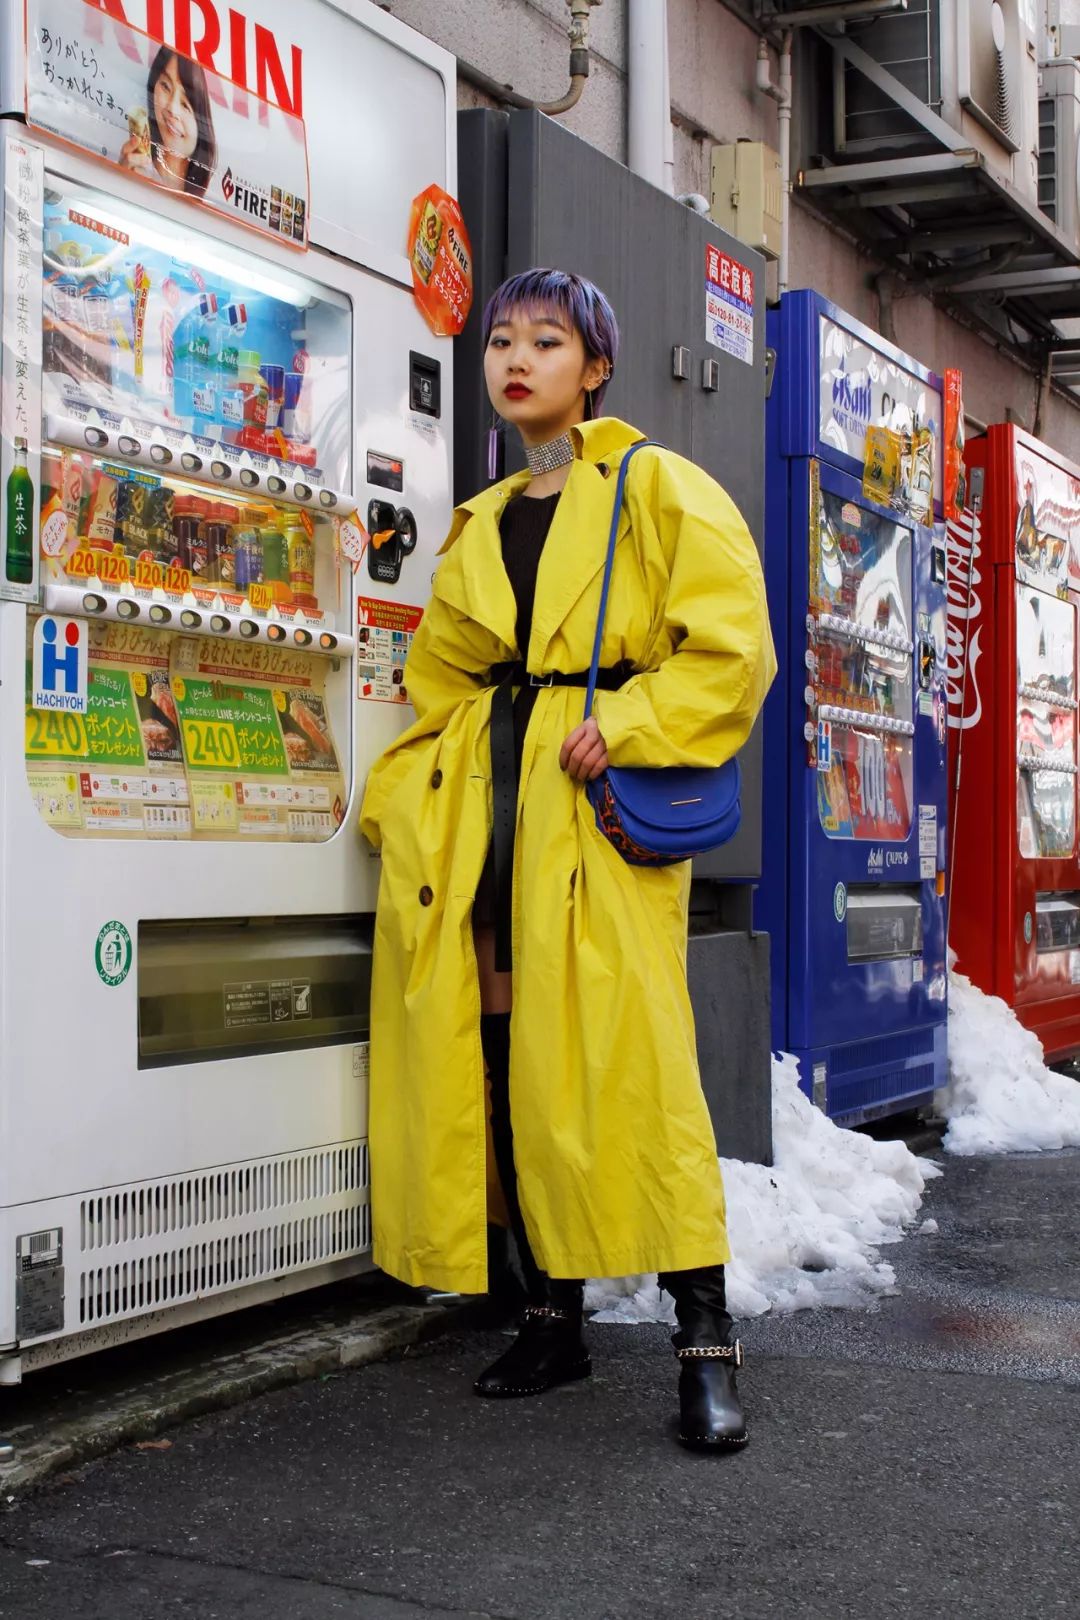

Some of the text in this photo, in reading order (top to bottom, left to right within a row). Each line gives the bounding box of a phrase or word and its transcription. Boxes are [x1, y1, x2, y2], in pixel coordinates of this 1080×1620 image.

[234, 185, 268, 221] FIRE
[452, 245, 468, 273] FIRE
[709, 250, 752, 302] 高圧危険
[15, 493, 28, 535] 生茶
[69, 551, 95, 575] 120
[103, 557, 128, 580] 120
[137, 563, 161, 586] 120
[167, 568, 189, 591] 120
[946, 506, 983, 730] CocaCola
[200, 640, 313, 675] あなたにごほうびプレゼント
[36, 693, 83, 710] HACHIYOH
[87, 696, 128, 709] イントコード
[216, 708, 234, 721] LINE
[26, 709, 82, 750] 240
[86, 712, 136, 739] ポイント
[237, 728, 280, 750] ポイント
[188, 724, 235, 763] 240
